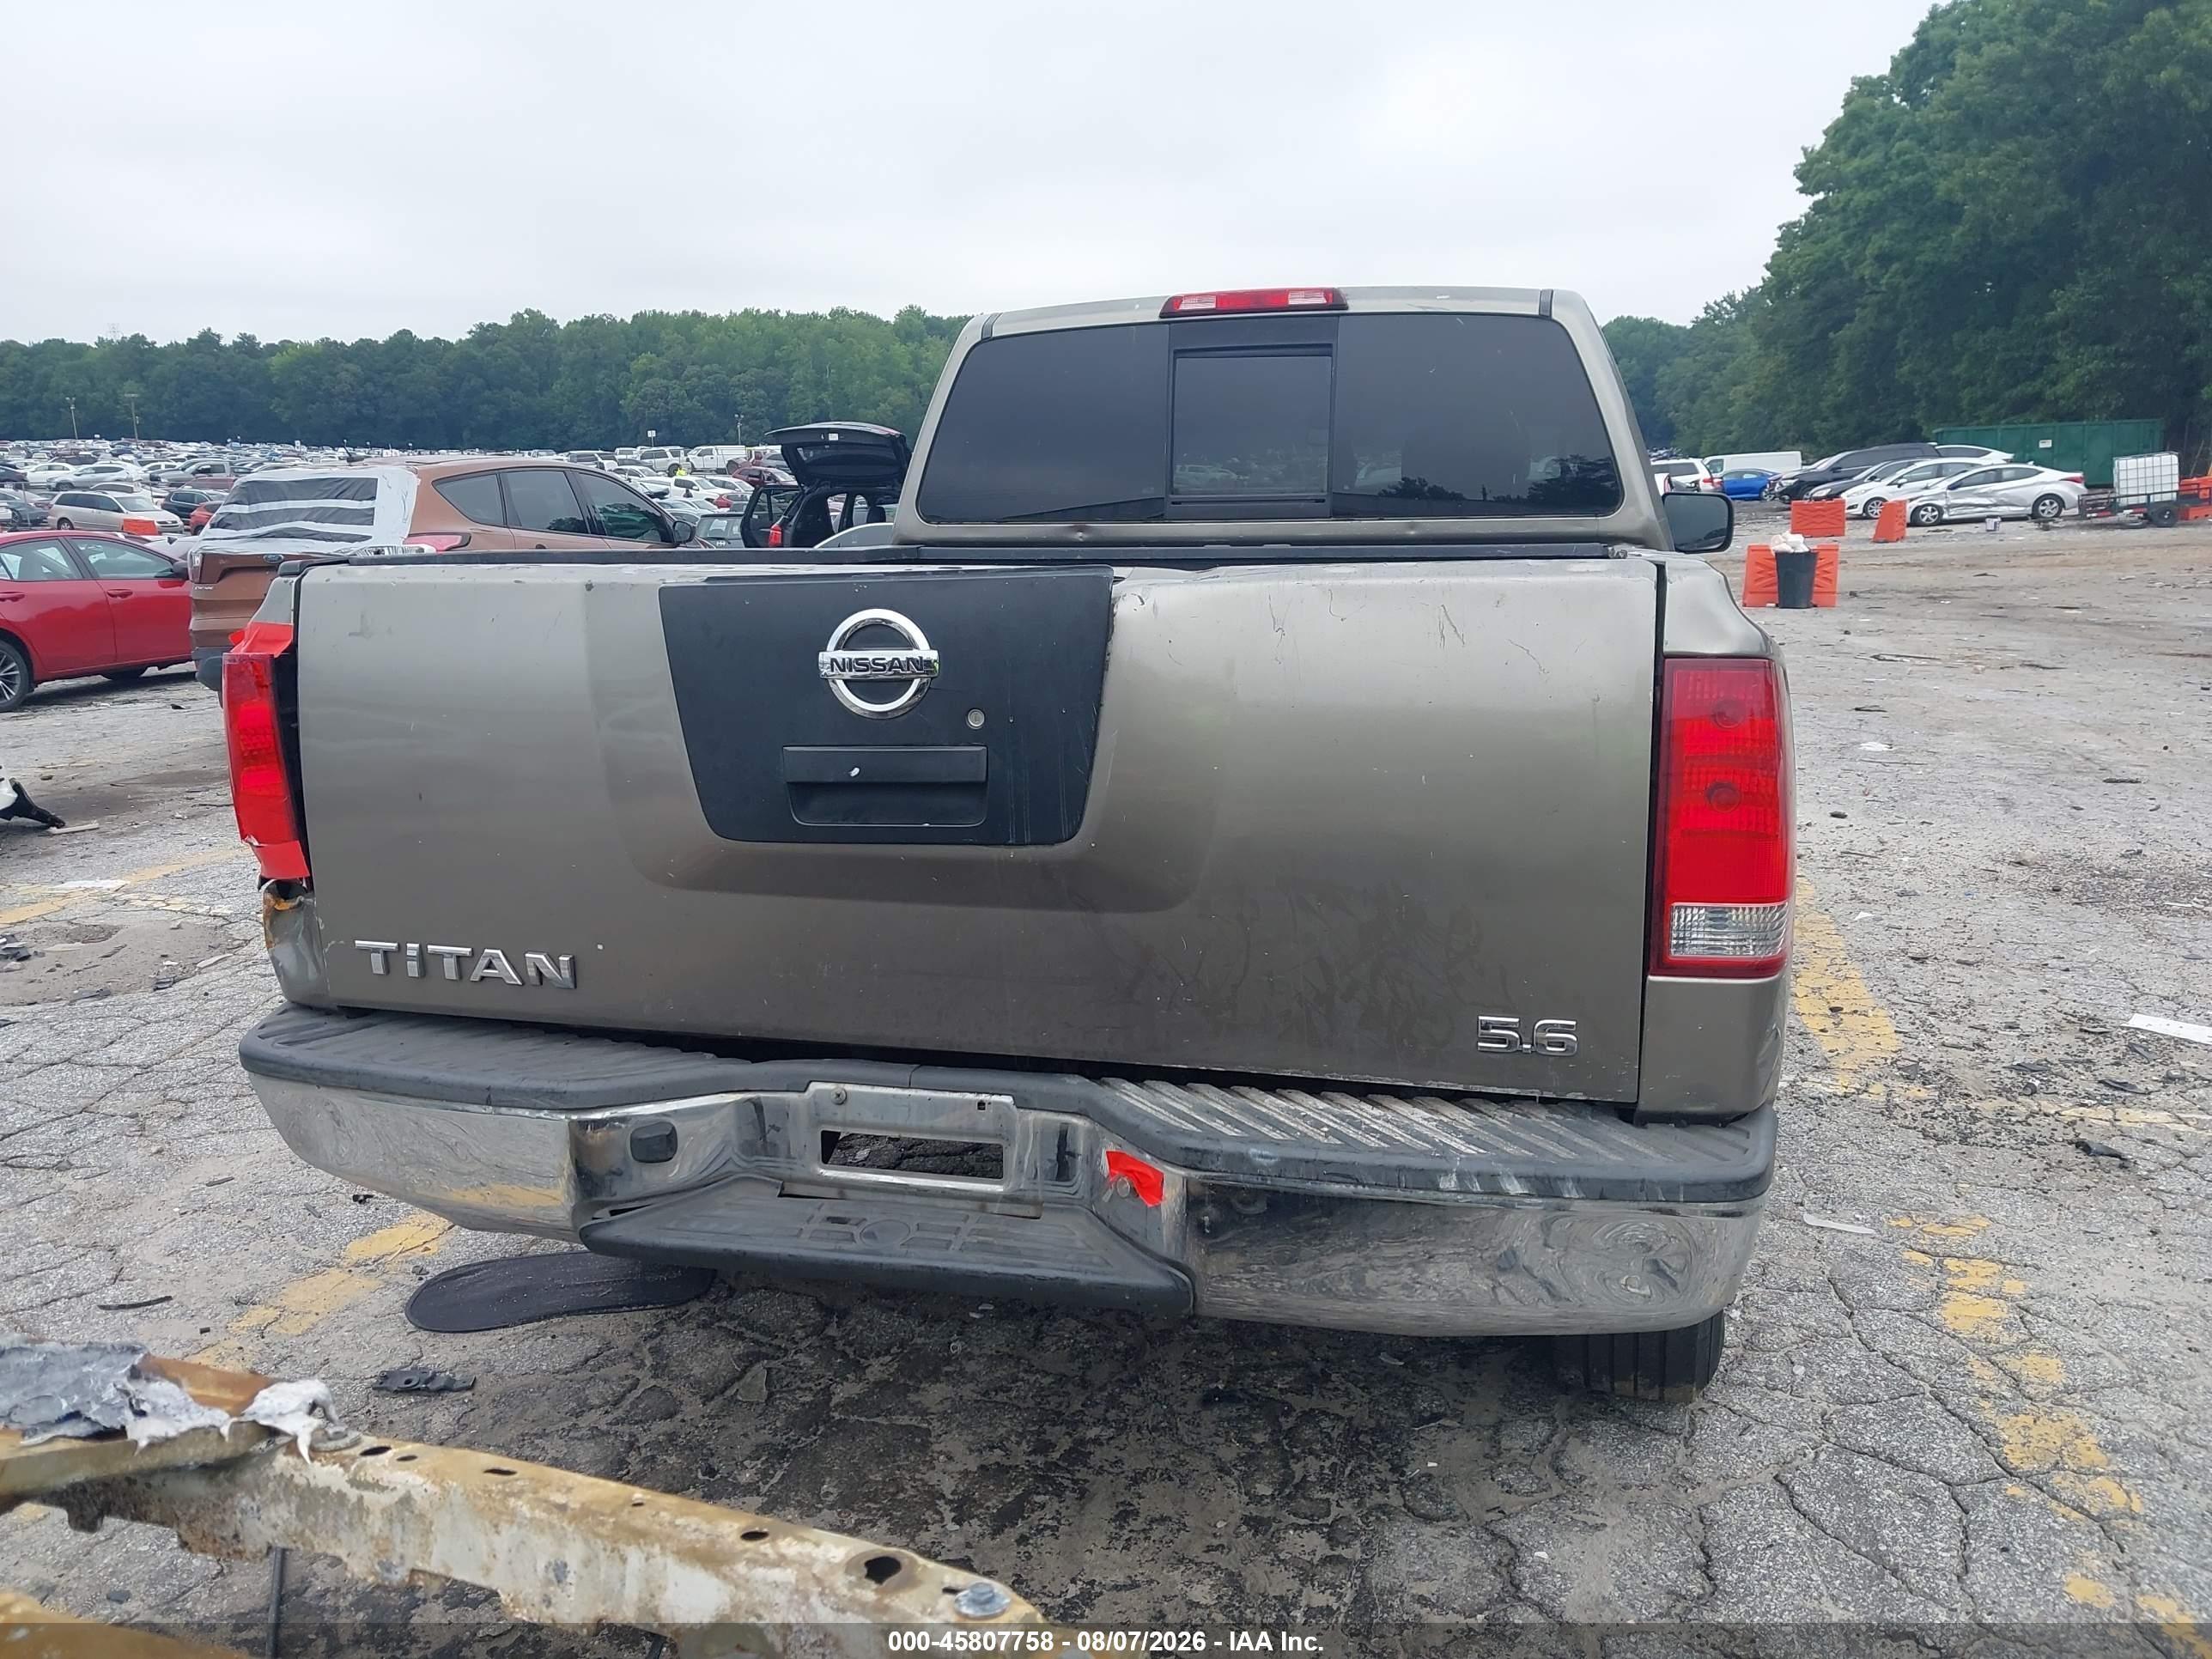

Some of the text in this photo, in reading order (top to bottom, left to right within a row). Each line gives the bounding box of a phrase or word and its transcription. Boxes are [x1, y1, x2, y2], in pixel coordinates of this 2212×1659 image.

[830, 656, 924, 673] NISSAN
[354, 939, 577, 989] TITAN
[1477, 1015, 1578, 1056] 5.6
